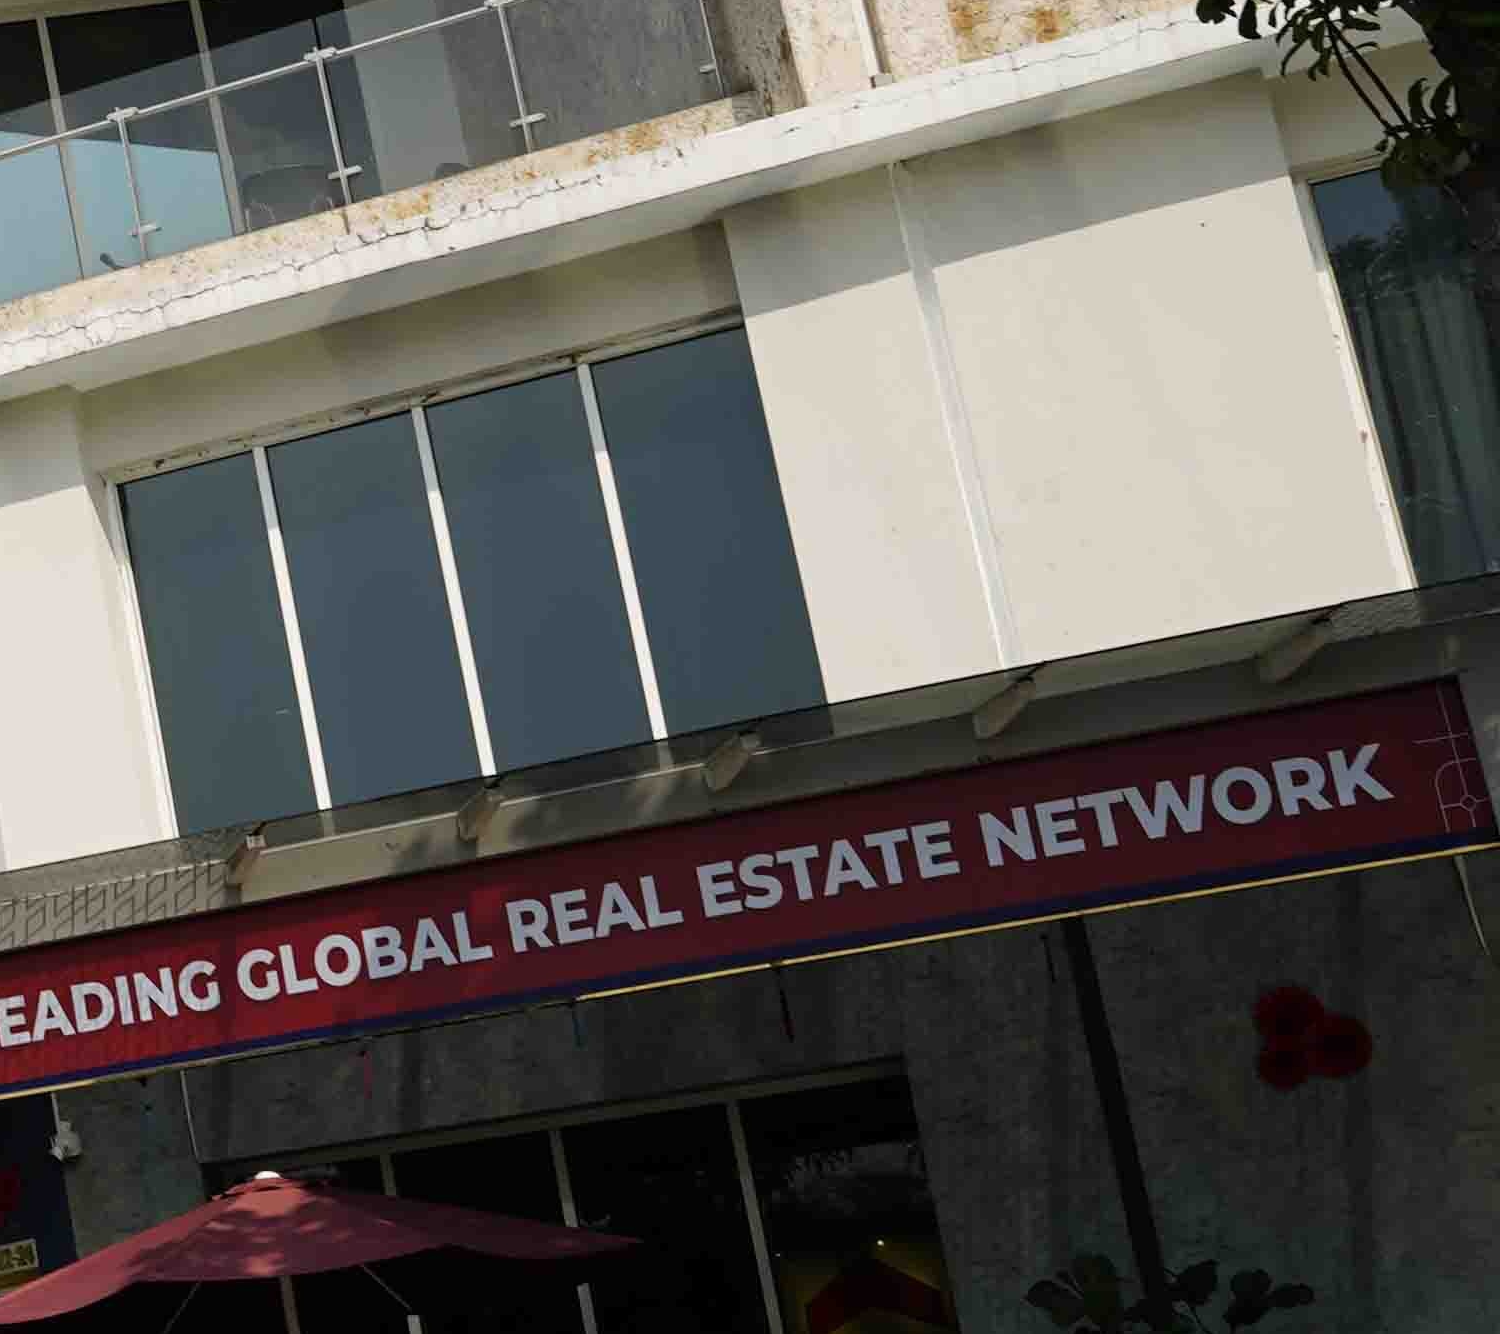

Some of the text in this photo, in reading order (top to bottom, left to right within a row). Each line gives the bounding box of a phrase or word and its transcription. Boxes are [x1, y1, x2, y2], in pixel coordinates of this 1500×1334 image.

[236, 911, 492, 1002] GLOBAL
[505, 874, 684, 953] REAL
[696, 821, 961, 919] ESTATE
[979, 743, 1395, 867] NETWORK
